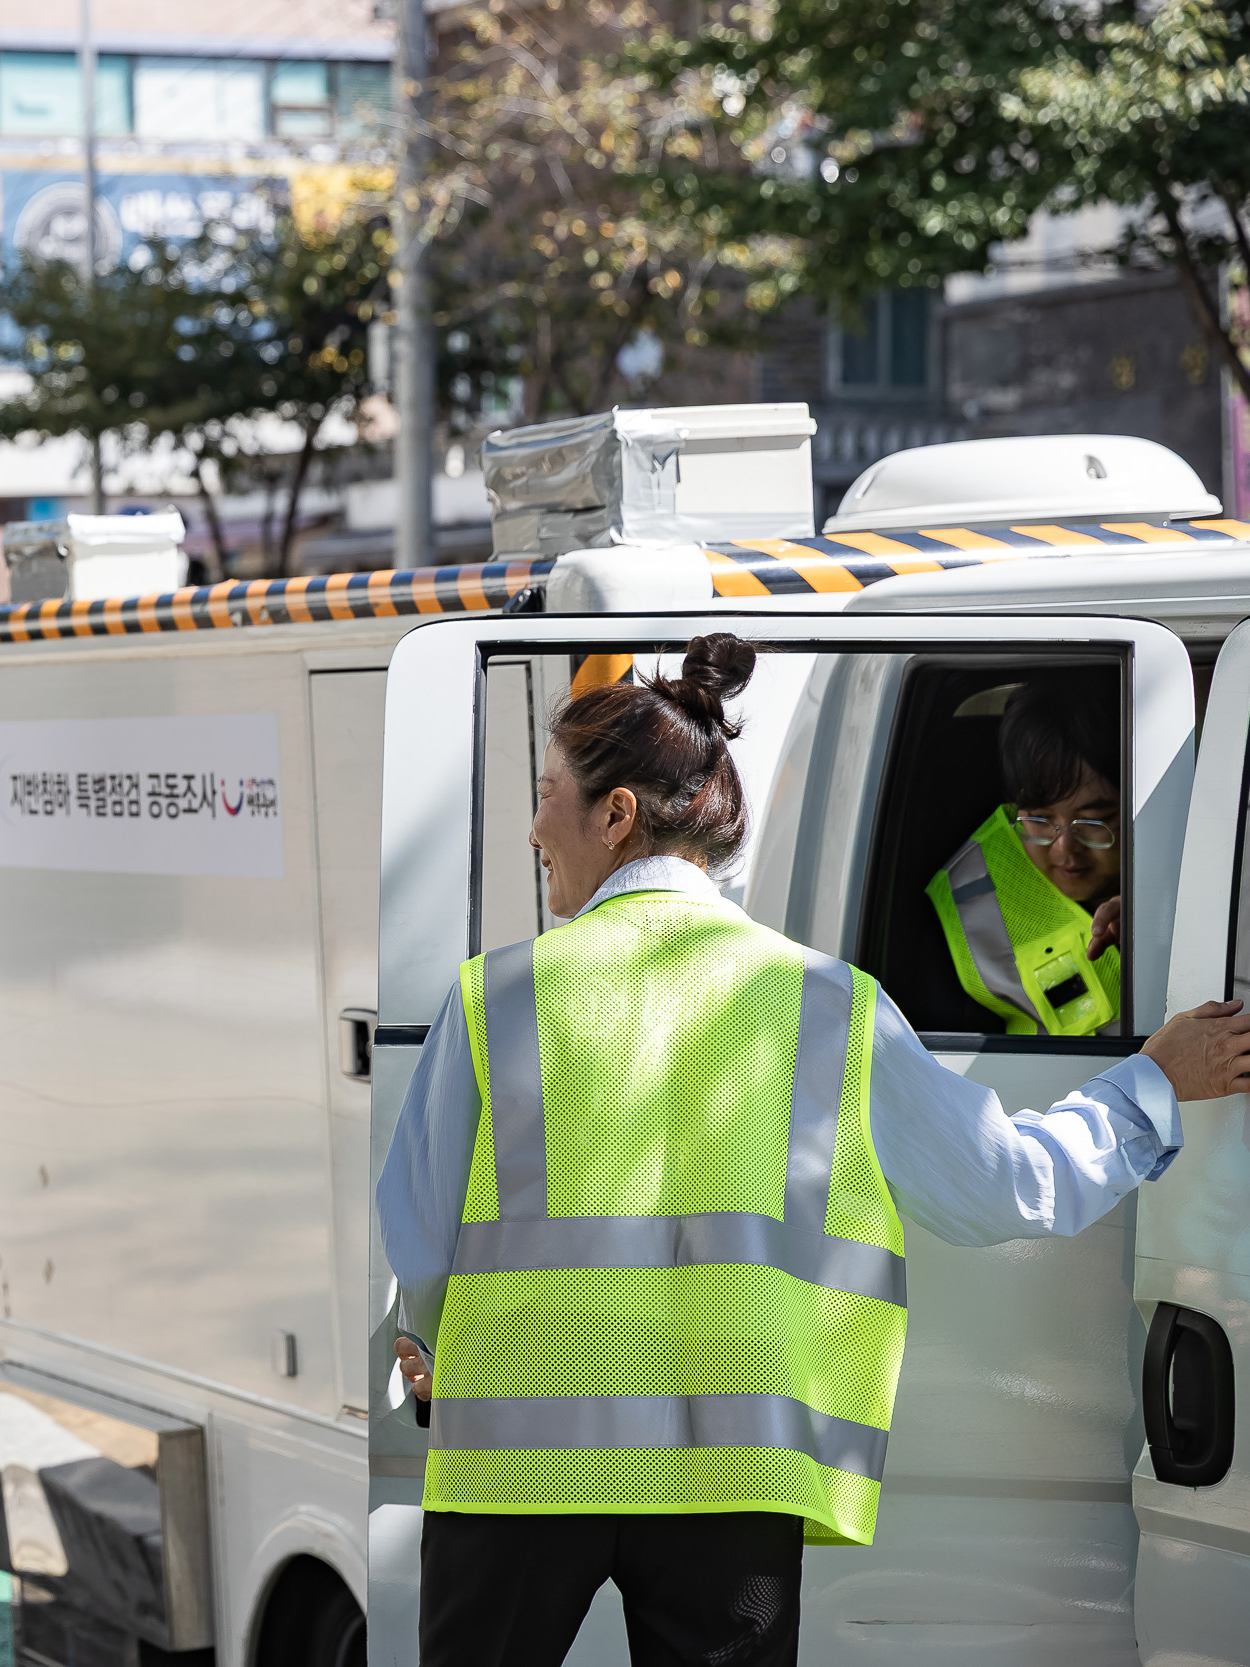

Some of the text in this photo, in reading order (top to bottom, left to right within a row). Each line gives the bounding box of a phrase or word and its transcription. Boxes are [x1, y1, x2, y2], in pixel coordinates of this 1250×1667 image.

[9, 772, 70, 816] 지반침하
[76, 772, 141, 817] 특별점검
[147, 771, 217, 819] 공동조사
